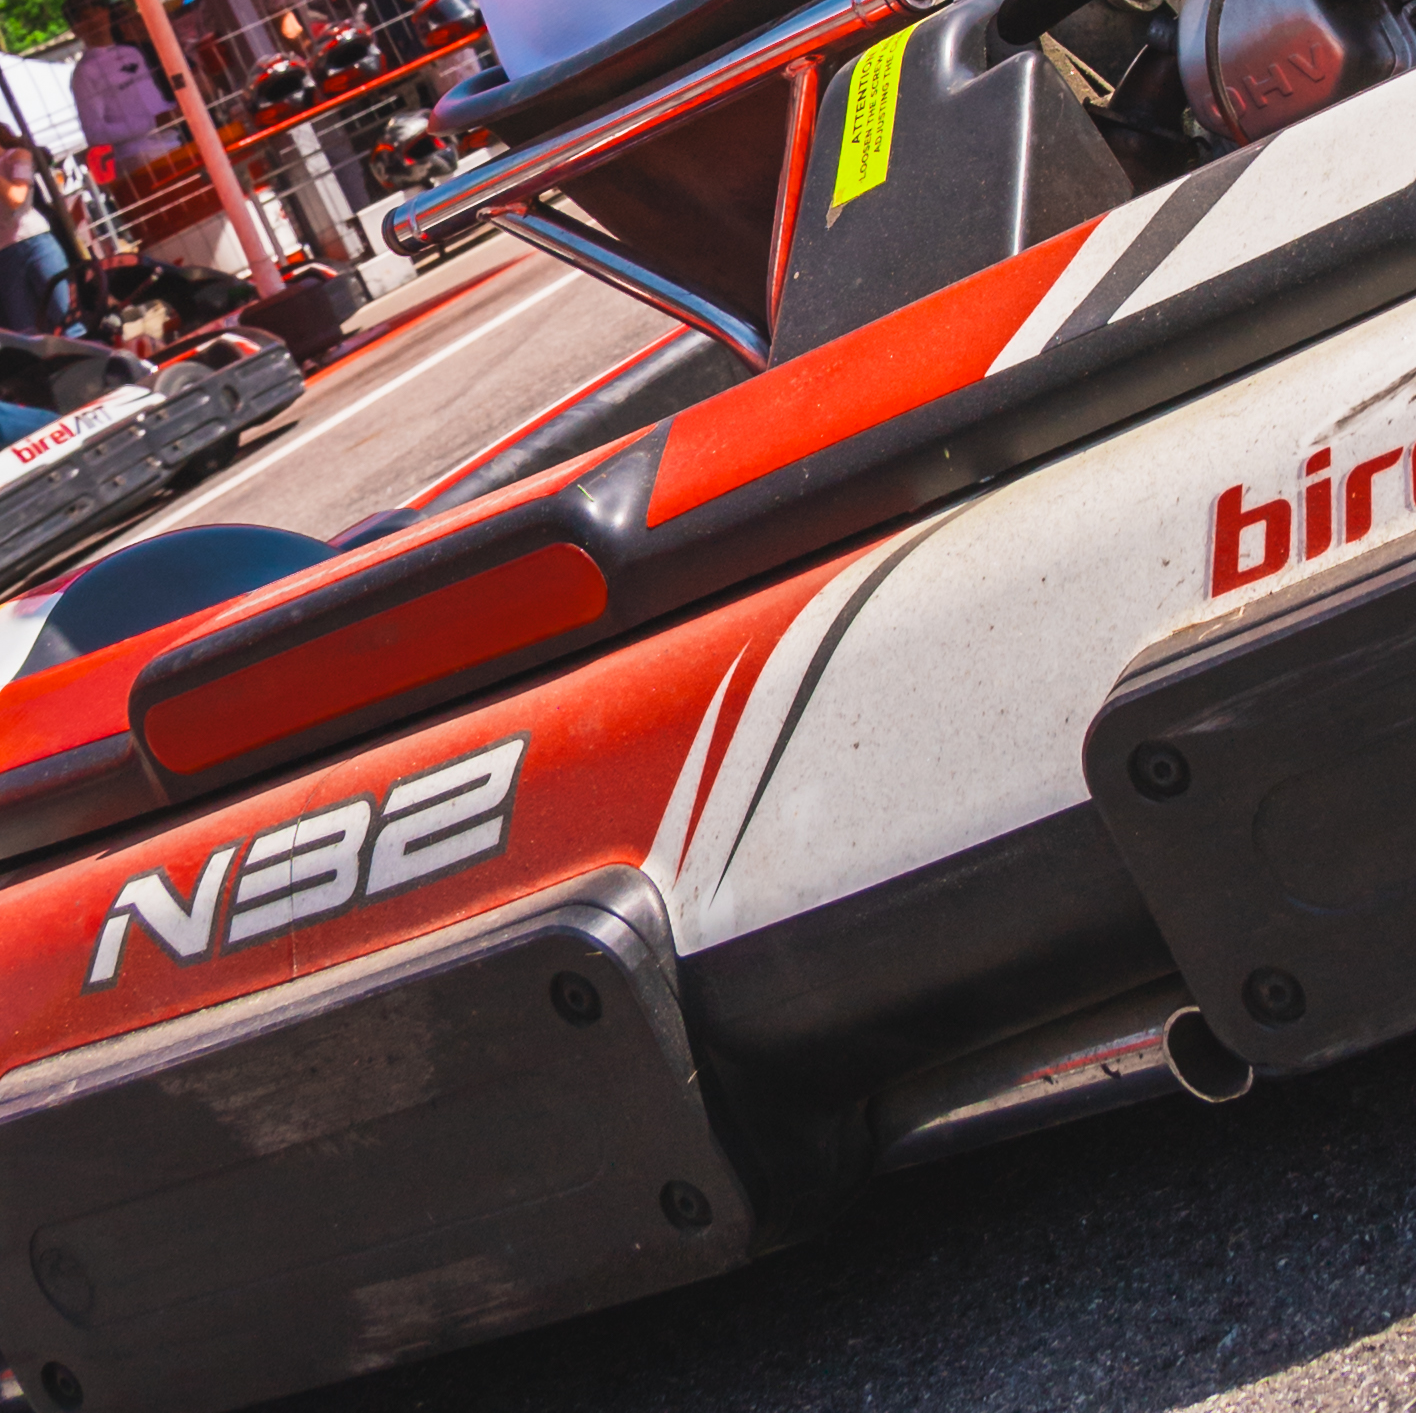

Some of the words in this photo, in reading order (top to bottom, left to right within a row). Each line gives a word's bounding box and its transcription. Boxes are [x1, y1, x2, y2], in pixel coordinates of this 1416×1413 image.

[851, 50, 877, 144] ATTENTION
[869, 53, 885, 99] SCREW
[873, 81, 890, 153] ADJUSTING
[882, 54, 895, 79] THE
[866, 99, 878, 126] THE
